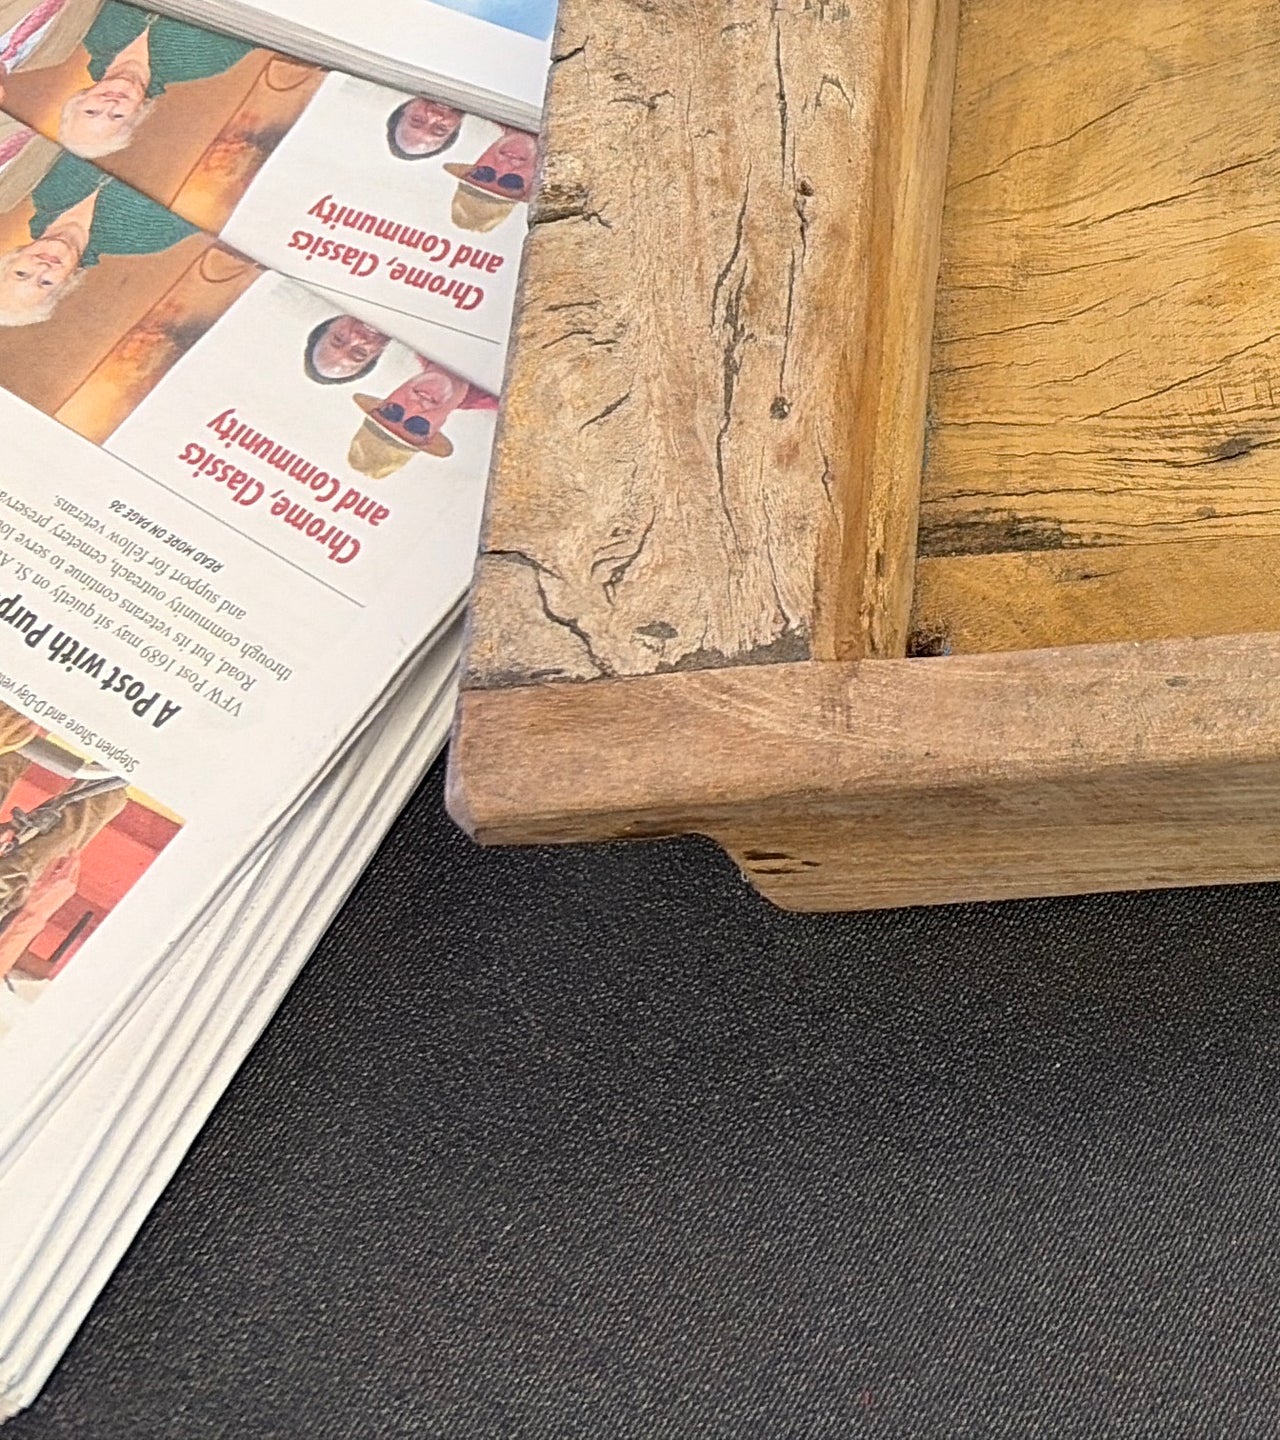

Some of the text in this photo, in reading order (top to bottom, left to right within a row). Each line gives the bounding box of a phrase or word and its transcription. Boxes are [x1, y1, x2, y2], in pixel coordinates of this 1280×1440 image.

[307, 194, 505, 274] and Community
[287, 230, 485, 311] Chrome, Classics
[206, 408, 390, 527] and Community
[178, 442, 361, 564] Chrome, Classics
[14, 532, 51, 559] serve
[48, 523, 108, 564] cemetery
[108, 499, 225, 574] READ MORE ON PAGE 36
[14, 561, 34, 582] St.
[49, 554, 66, 570] to
[53, 494, 247, 620] and support for fellow veterans.
[31, 573, 51, 590] on
[64, 564, 120, 603] continue
[110, 558, 167, 601] outreach,
[48, 584, 96, 618] quietly
[118, 598, 172, 637] veterans
[92, 613, 115, 630] sit
[112, 624, 144, 649] may
[164, 596, 241, 647] community
[0, 593, 182, 729] A Post with Purp
[139, 645, 177, 673] 1689
[172, 632, 193, 652] its
[189, 643, 216, 667] but
[240, 642, 293, 681] through
[175, 665, 209, 693] Post
[215, 656, 257, 692] Road,
[202, 686, 243, 717] VFW
[0, 672, 140, 773] Stephen Shore and D-Day vet
